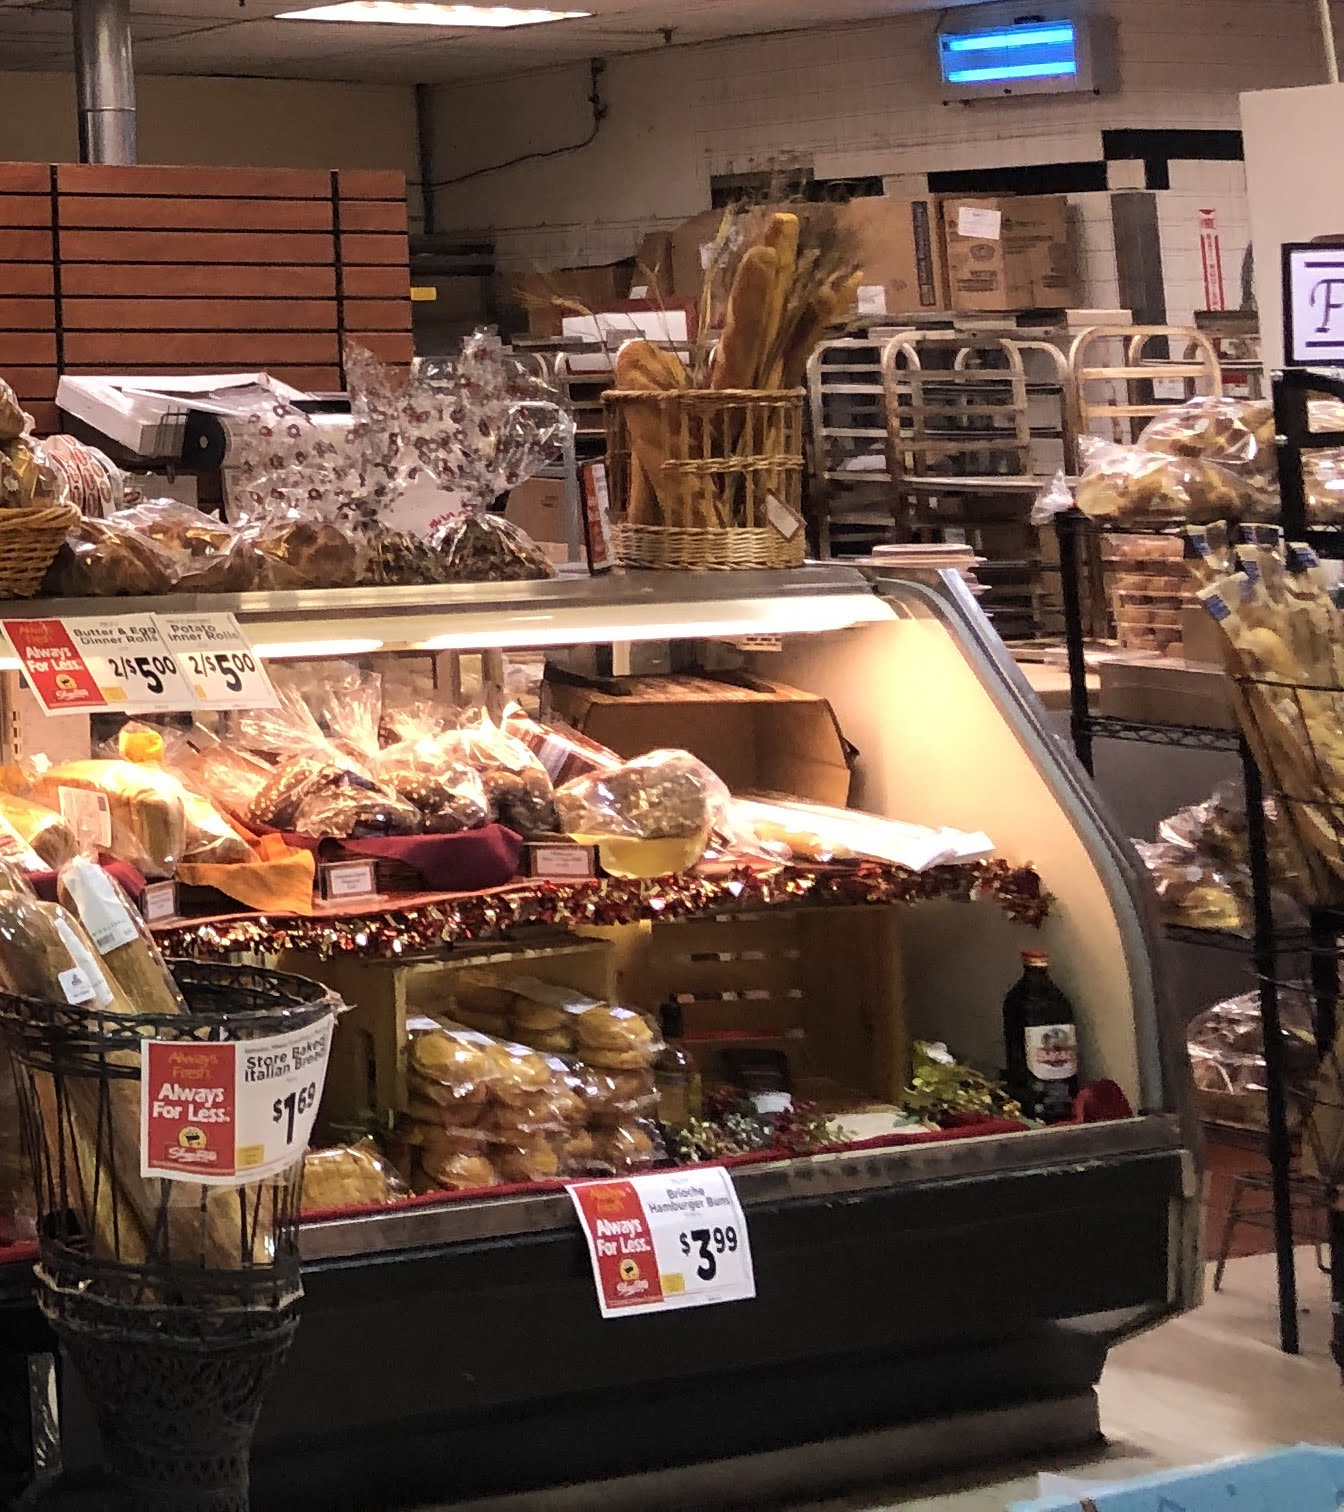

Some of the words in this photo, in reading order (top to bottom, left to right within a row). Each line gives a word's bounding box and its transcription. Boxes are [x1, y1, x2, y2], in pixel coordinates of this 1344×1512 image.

[73, 627, 114, 638] Butter
[118, 626, 127, 636] &
[129, 626, 158, 638] Egg
[167, 633, 203, 642] inner
[206, 630, 242, 641] Rolls
[170, 624, 217, 635] Potato
[80, 636, 124, 646] Dinner
[126, 633, 159, 643] Rolls
[25, 645, 72, 661] Always
[26, 659, 50, 673] For
[50, 658, 84, 672] Less.
[246, 1052, 288, 1069] Store
[244, 1063, 291, 1083] Italian
[157, 1082, 225, 1108] Always
[152, 1100, 183, 1120] For
[187, 1103, 231, 1123] Less.
[666, 1186, 706, 1200] Brioche
[648, 1197, 705, 1215] Hamburger
[596, 1217, 643, 1238] Always
[597, 1238, 618, 1257] For
[619, 1236, 651, 1255] Less.
